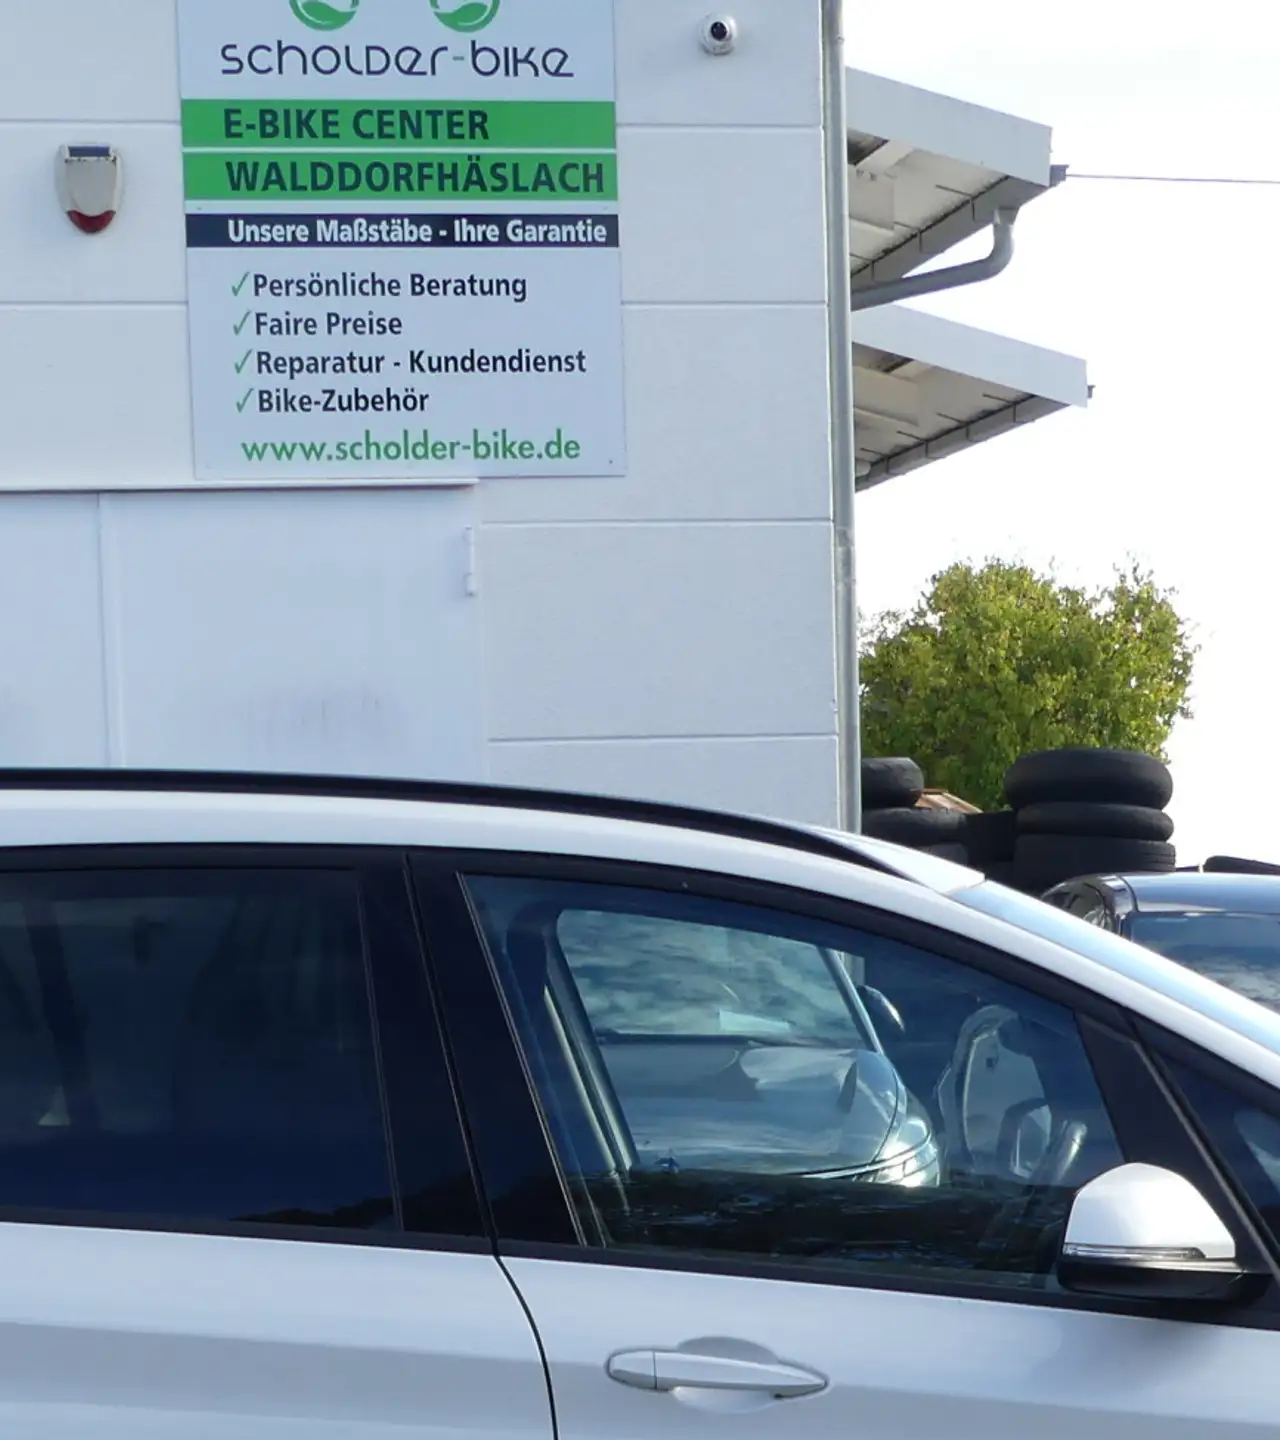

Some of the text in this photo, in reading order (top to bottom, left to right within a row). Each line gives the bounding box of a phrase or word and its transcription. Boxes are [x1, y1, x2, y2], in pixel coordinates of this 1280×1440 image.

[224, 108, 490, 140] E-BIKE CENTER
[226, 155, 604, 193] WALDDORFHÄSLACH
[227, 219, 309, 242] Unsere
[316, 219, 432, 242] Maßstäbe
[454, 219, 500, 242] Ihre
[506, 219, 608, 242] Garantie
[253, 272, 527, 301] Persönliche Beratung
[255, 311, 403, 335] Faire Preise
[257, 351, 385, 379] Reparatur
[410, 349, 586, 373] Kundendienst
[258, 388, 429, 412] Bike-Zubehör
[241, 429, 581, 461] www.scholder-bike.de
